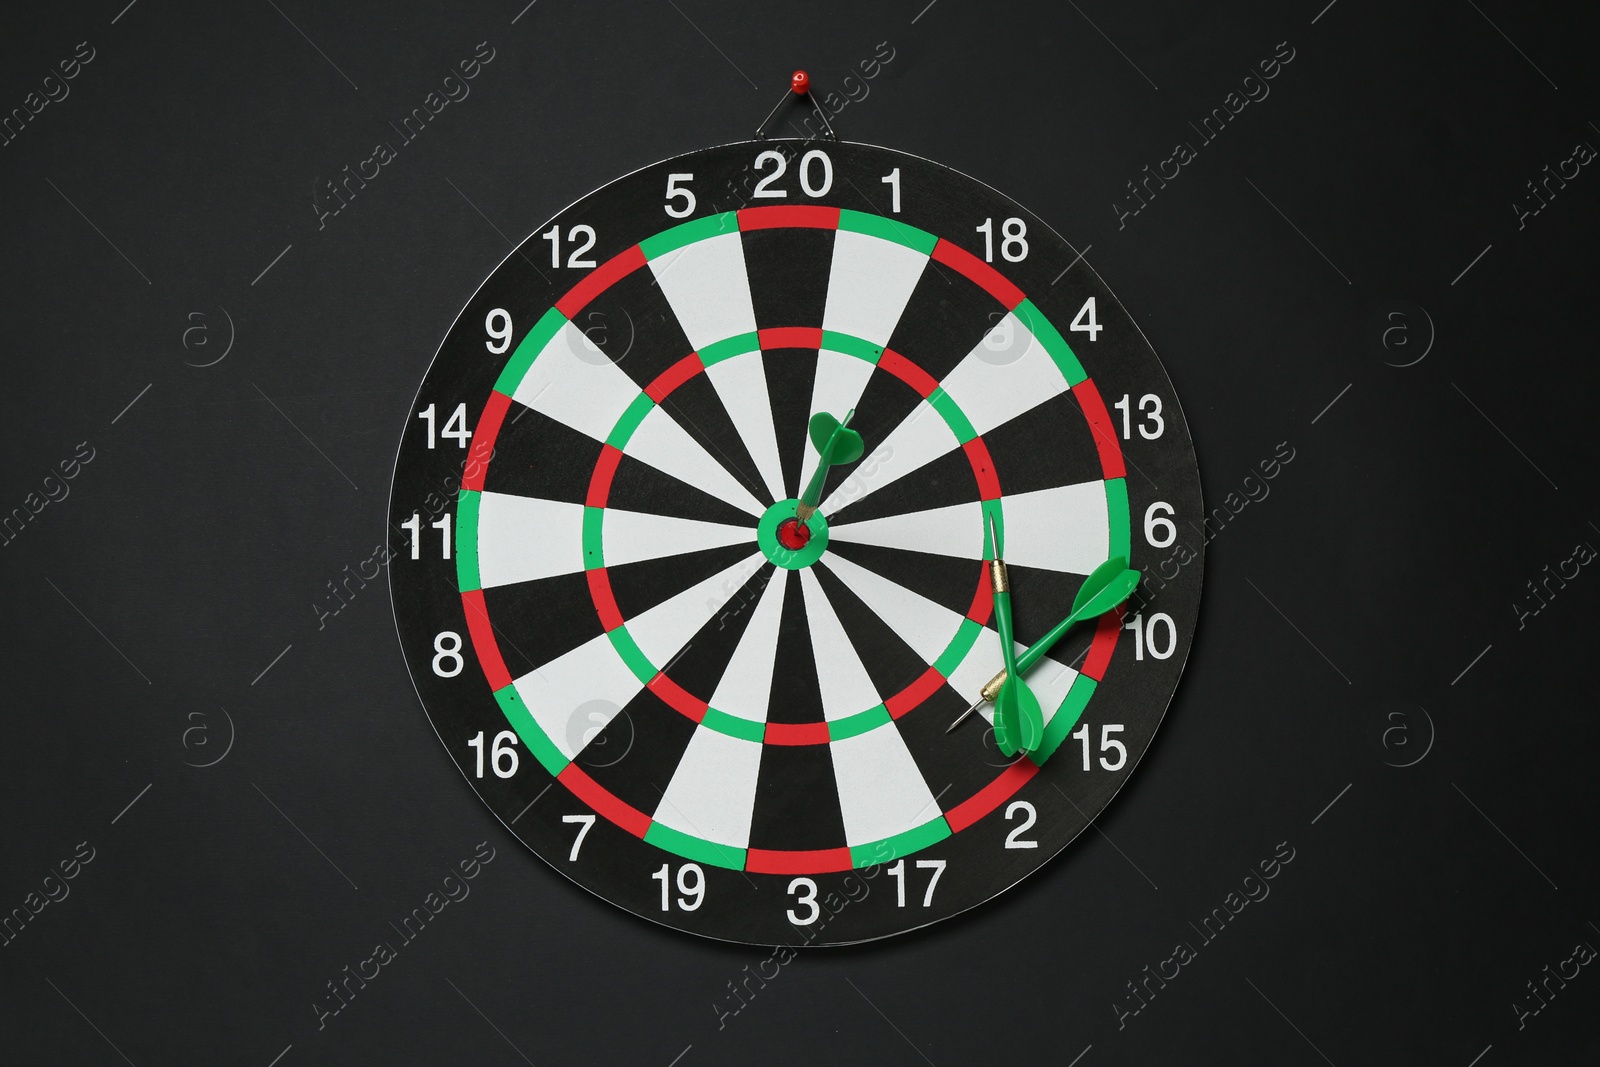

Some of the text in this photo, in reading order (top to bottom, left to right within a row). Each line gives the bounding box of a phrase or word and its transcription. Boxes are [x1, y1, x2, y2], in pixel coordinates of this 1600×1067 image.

[665, 174, 696, 218] 5
[753, 150, 833, 198] 20
[882, 168, 900, 212] 1
[543, 225, 596, 268] 12
[976, 218, 1028, 262] 18
[486, 308, 512, 354] 9
[1070, 297, 1102, 341] 4
[419, 403, 472, 449] 14
[1115, 394, 1164, 439] 13
[402, 513, 450, 559] 11
[1144, 502, 1176, 548] 6
[432, 631, 463, 677] 8
[1126, 613, 1176, 660] 10
[468, 731, 518, 778] 16
[1073, 724, 1127, 771] 15
[563, 815, 595, 861] 7
[1005, 801, 1038, 848] 2
[652, 863, 705, 911] 19
[787, 878, 819, 925] 3
[888, 860, 946, 907] 17
